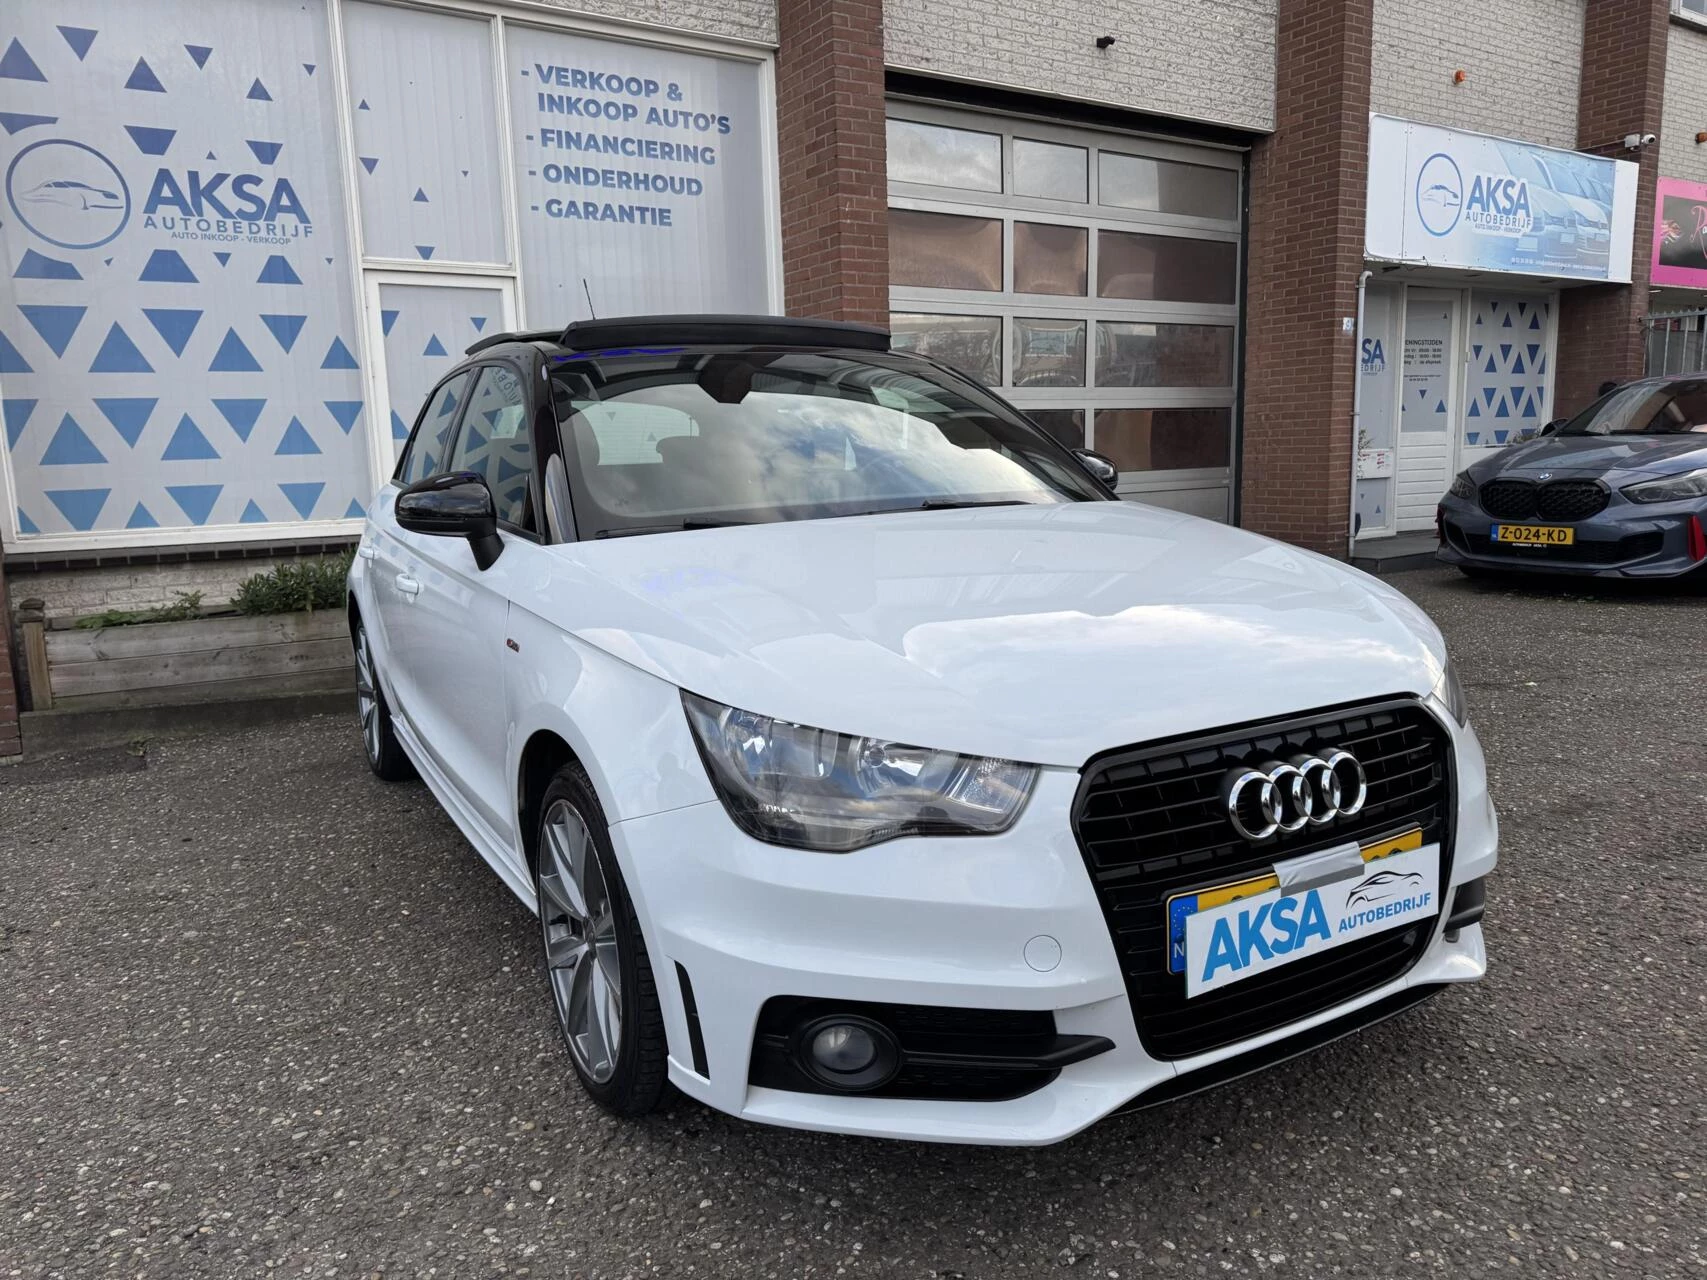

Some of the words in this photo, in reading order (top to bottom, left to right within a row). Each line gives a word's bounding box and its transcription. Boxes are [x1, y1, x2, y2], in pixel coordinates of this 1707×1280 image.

[535, 63, 660, 98] VERKOOP
[666, 82, 683, 102] &
[538, 92, 638, 122] INKOOP
[645, 106, 731, 135] AUTO'S
[540, 128, 716, 165] FINANCIERING
[543, 163, 703, 196] ONDERHOUD
[143, 168, 312, 225] AKSA
[1466, 175, 1531, 217] AKSA
[143, 215, 313, 238] AUTOBEDRIJF
[545, 198, 673, 227] GARANTIE
[1465, 211, 1532, 229] AUTOBEDRIJF
[171, 231, 199, 240] AUTO
[200, 232, 239, 242] INKOOP
[246, 235, 292, 245] VERKOOP
[1361, 338, 1386, 365] SA
[1360, 363, 1386, 373] EDRIJF
[1501, 526, 1567, 543] Z-024-KD
[1174, 941, 1185, 959] N
[1201, 888, 1332, 983] AKSA
[1338, 892, 1432, 934] AUTOBEDRIJF
